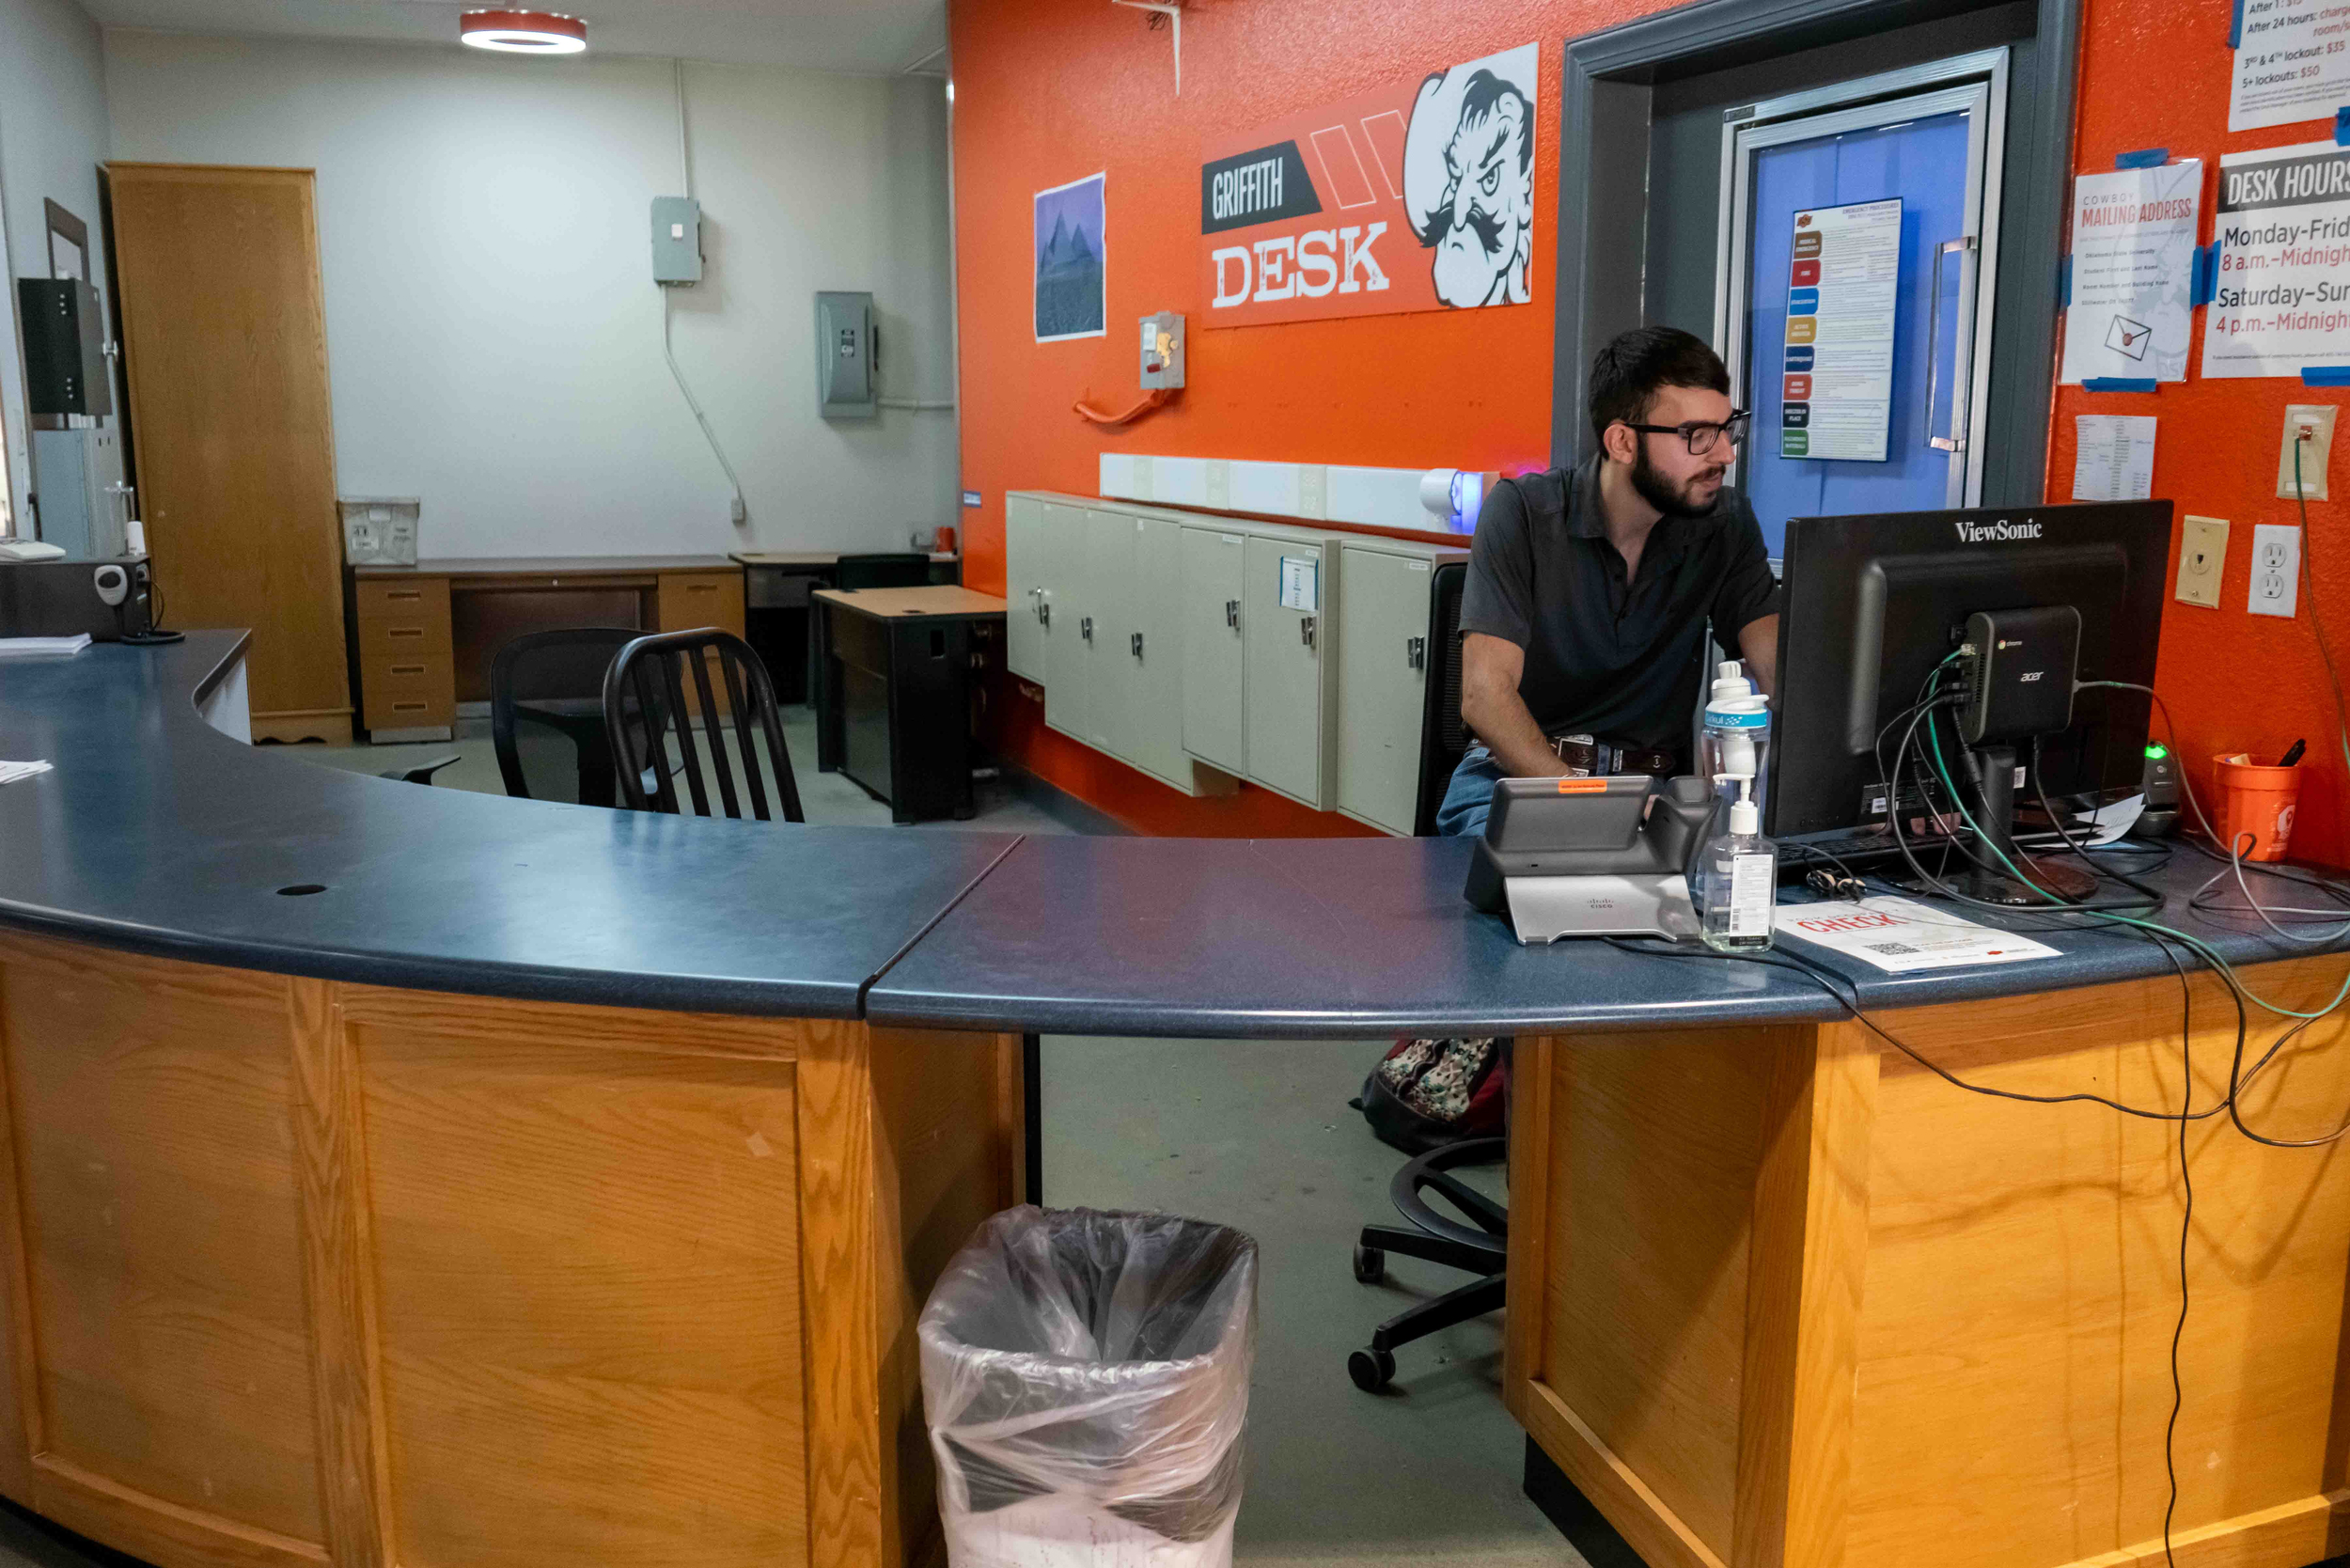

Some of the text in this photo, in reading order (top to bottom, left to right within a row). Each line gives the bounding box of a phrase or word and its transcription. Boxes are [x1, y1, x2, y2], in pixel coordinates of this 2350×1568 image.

[2247, 6, 2350, 34] After 24 hours: charg
[2248, 3, 2273, 15] After
[2259, 55, 2266, 67] &
[2284, 45, 2325, 61] lockout:
[2326, 40, 2346, 55] $35
[2242, 65, 2321, 88] 5+ lockouts: $50
[1213, 157, 1283, 219] GRIFFITH
[2228, 167, 2280, 206] DESK
[2083, 194, 2134, 206] COWBOY
[2081, 197, 2192, 228] MAILING ADDRESS
[1212, 222, 1389, 308] DESK
[2222, 254, 2232, 271] 8
[2216, 316, 2226, 334] 4
[1955, 517, 2043, 543] ViewSonic
[2020, 671, 2044, 682] acer
[1796, 913, 1911, 933] CHECK
